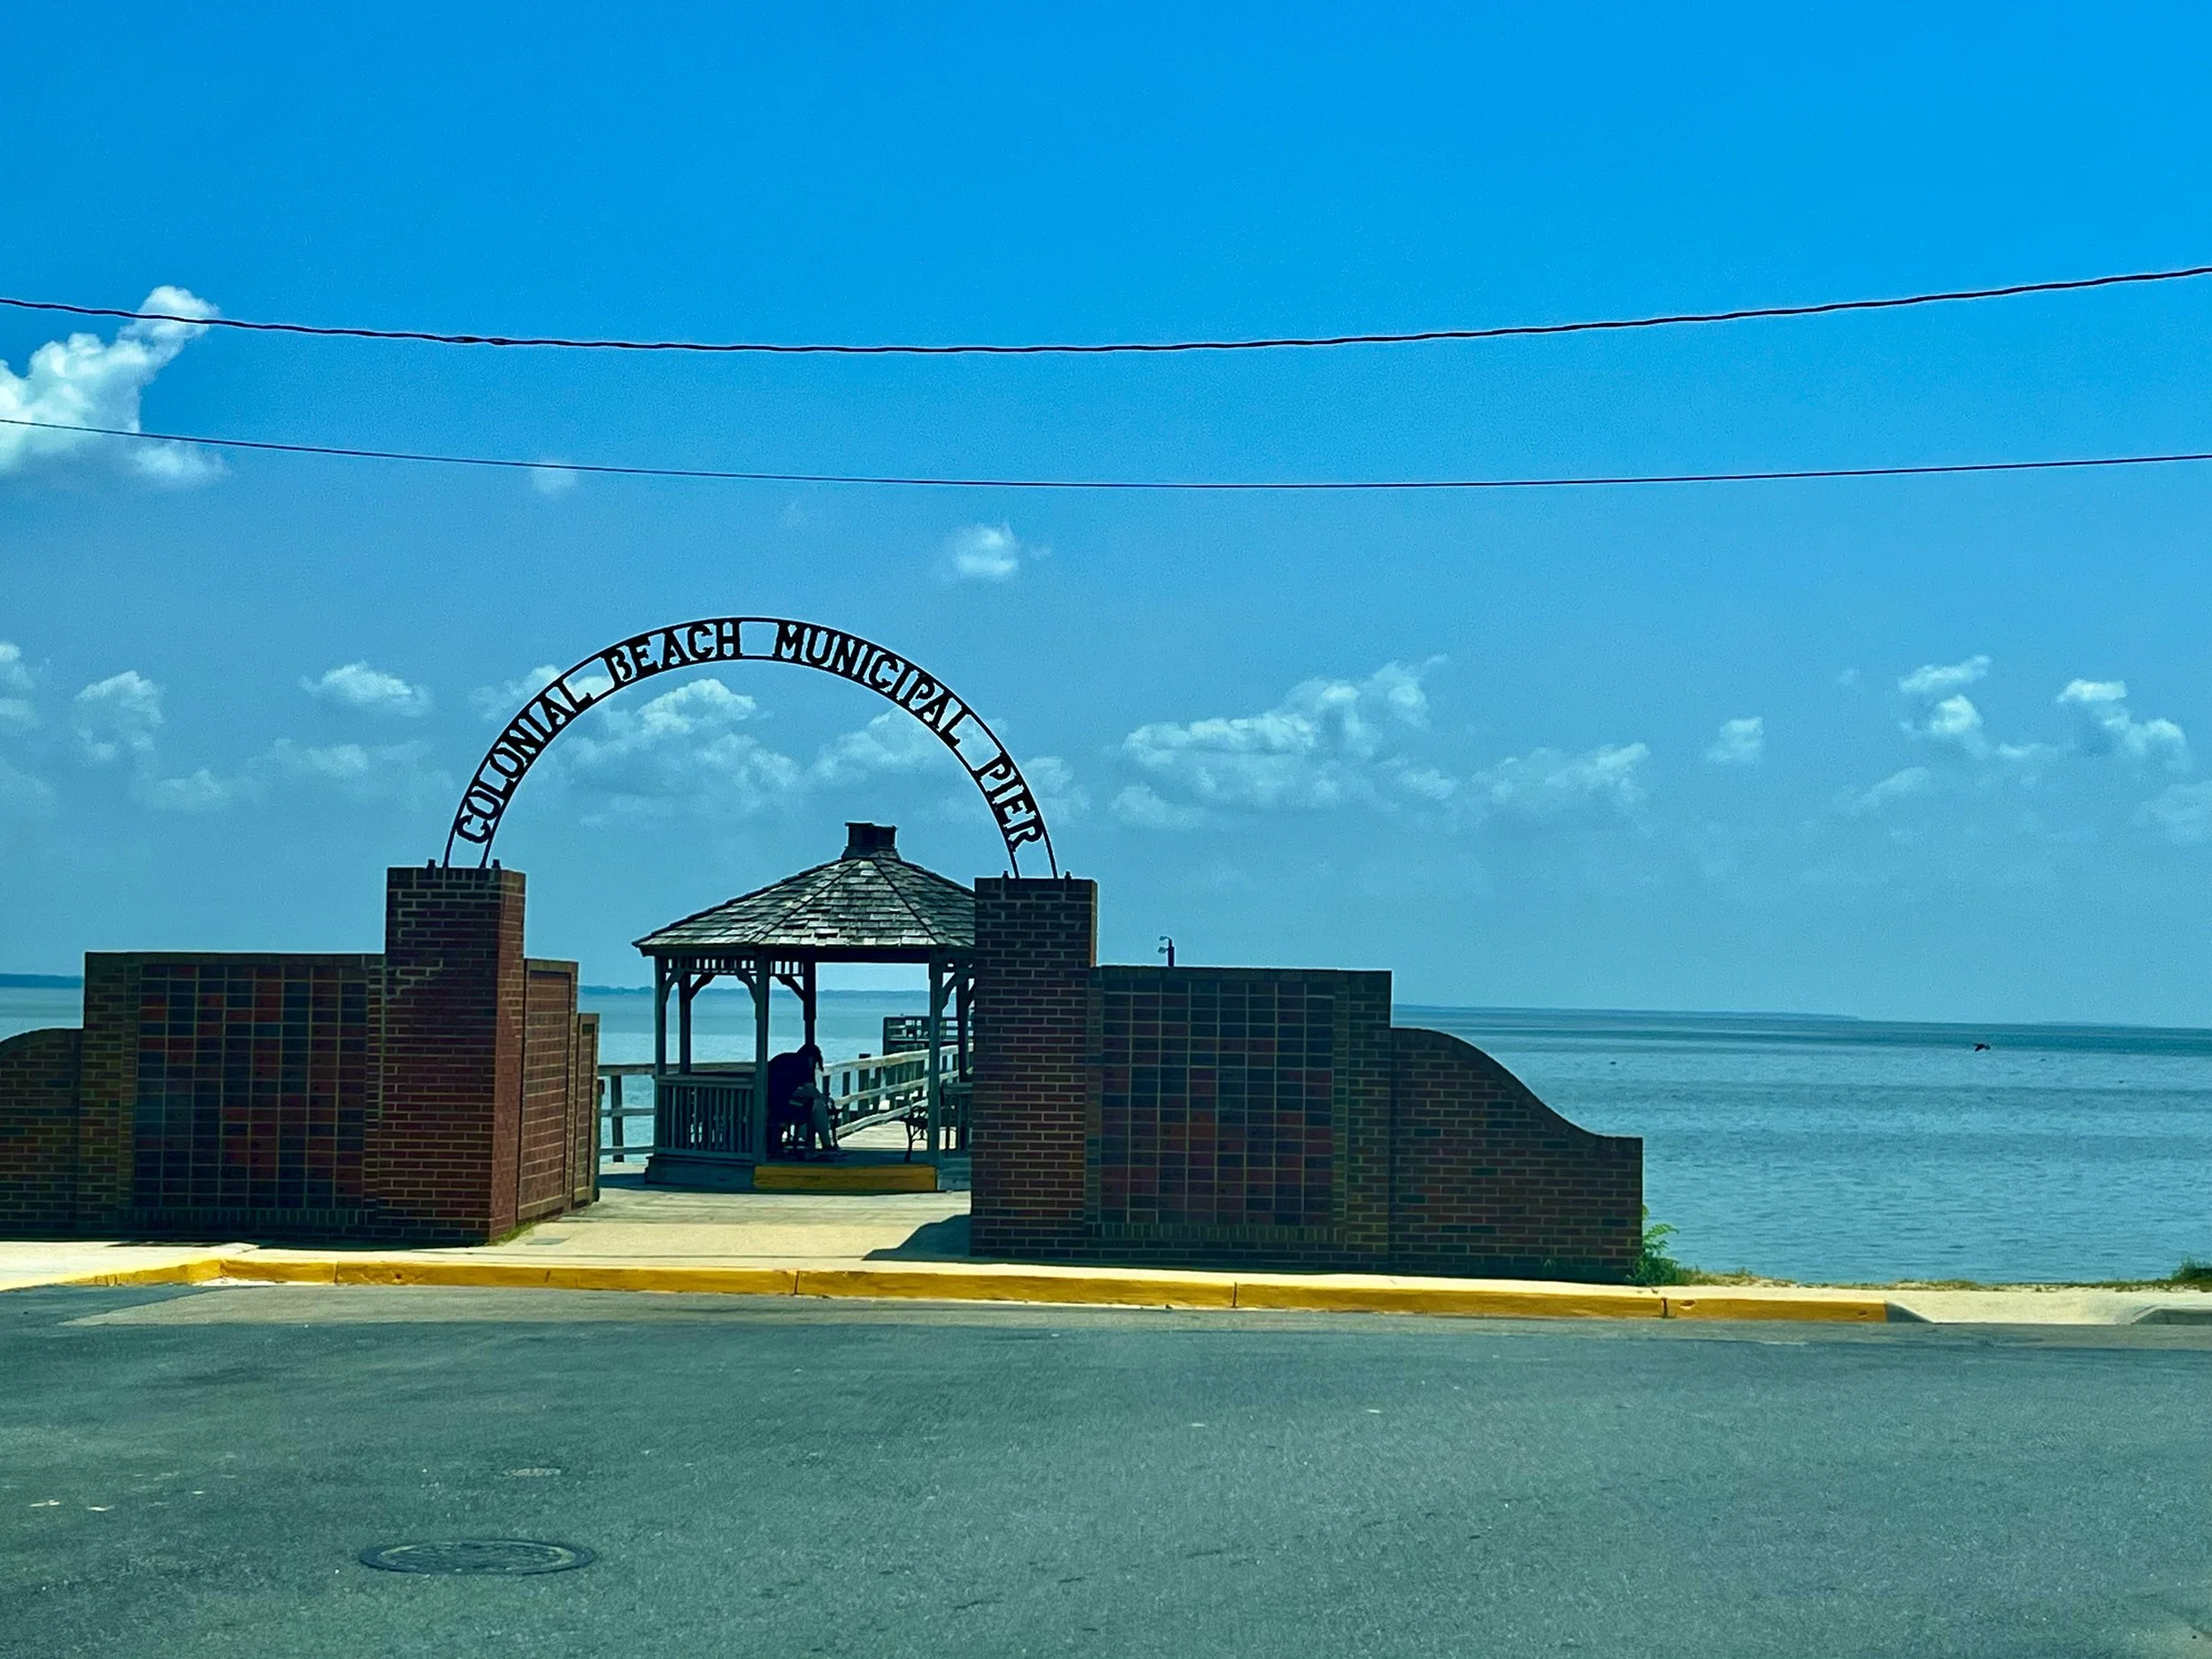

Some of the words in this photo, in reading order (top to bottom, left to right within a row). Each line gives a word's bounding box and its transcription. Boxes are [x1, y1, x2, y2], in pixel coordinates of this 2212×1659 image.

[456, 680, 593, 844] COLONIAL
[603, 622, 741, 689] BEACH
[772, 622, 974, 748] MUNICIPAL
[972, 752, 1044, 852] PIER
